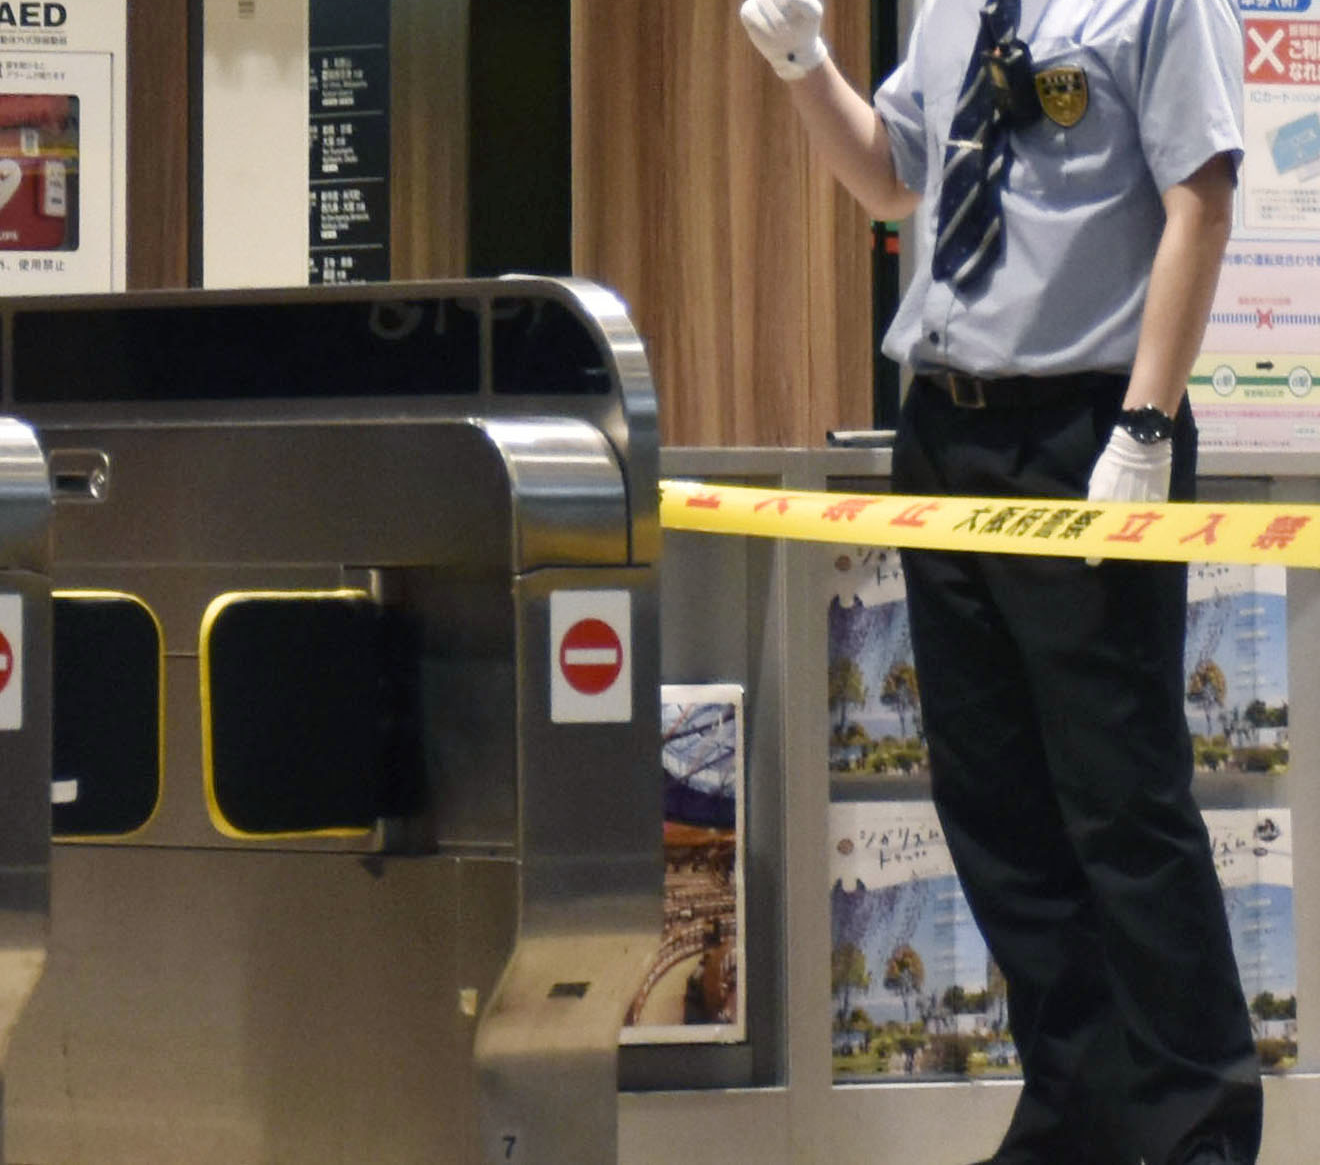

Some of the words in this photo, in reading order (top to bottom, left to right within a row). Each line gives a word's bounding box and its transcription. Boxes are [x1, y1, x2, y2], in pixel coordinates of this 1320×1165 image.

[952, 505, 1105, 541] 大阪府警察
[503, 1136, 517, 1160] 7
